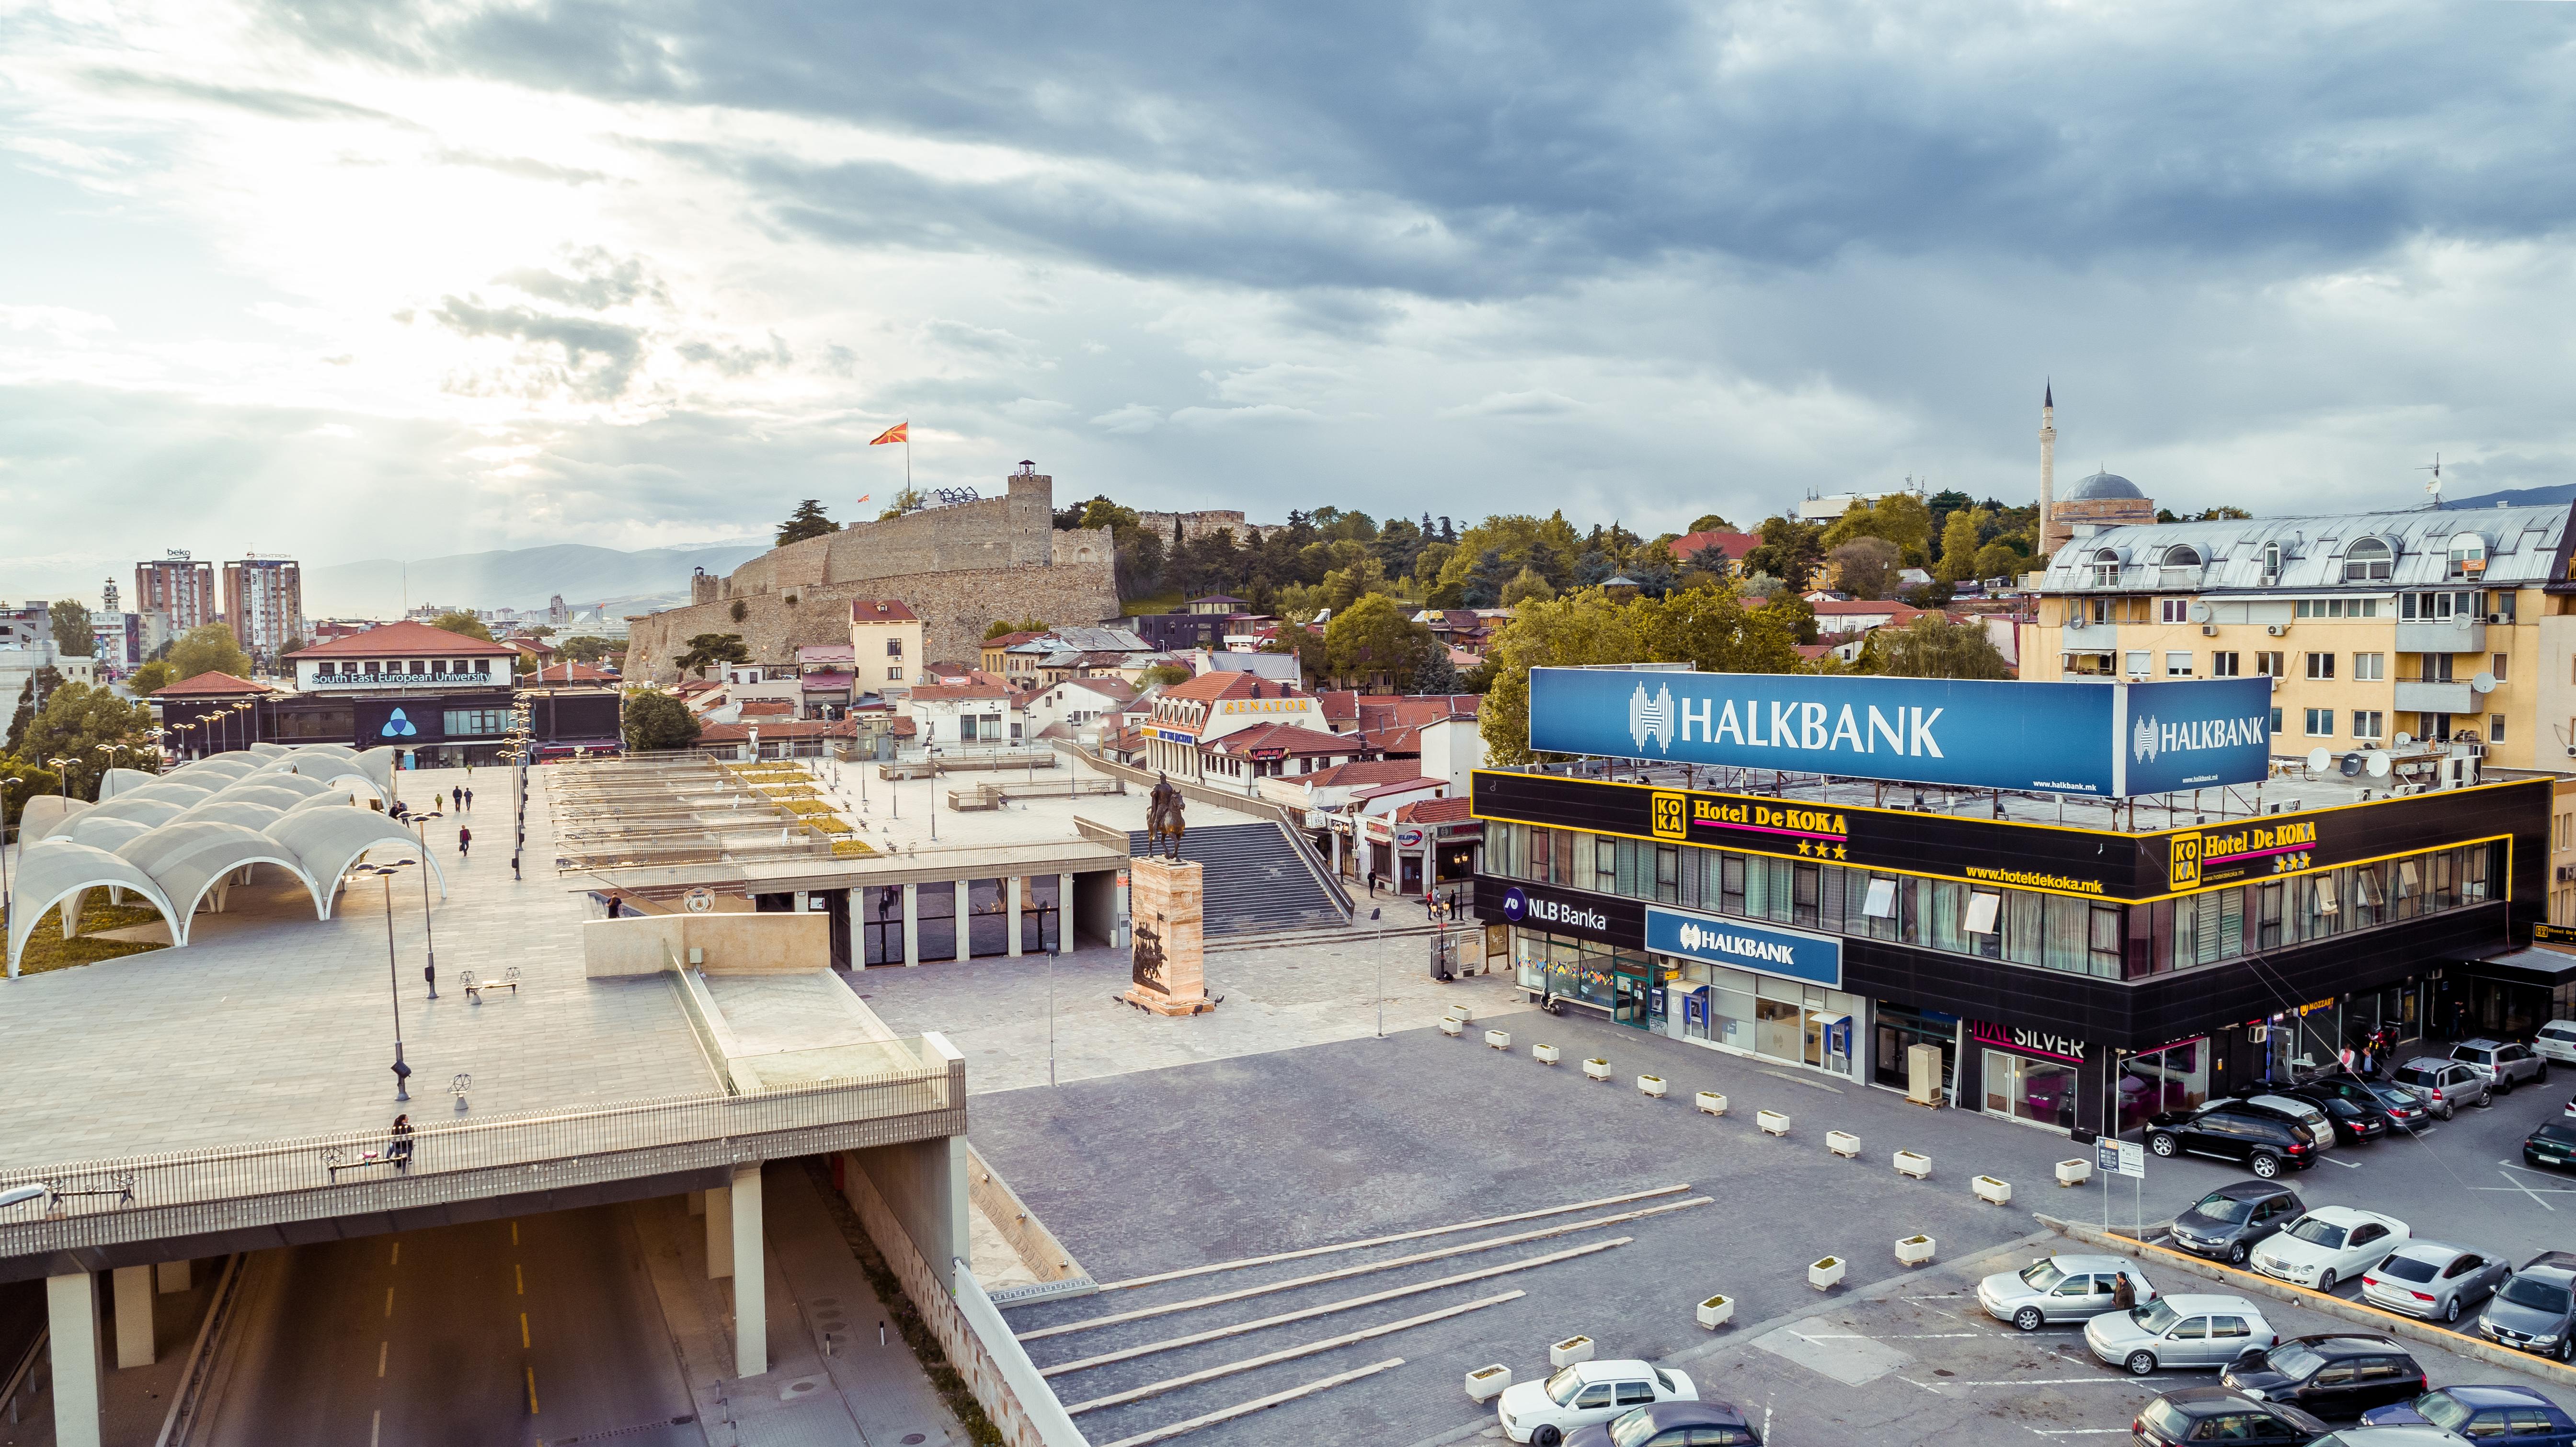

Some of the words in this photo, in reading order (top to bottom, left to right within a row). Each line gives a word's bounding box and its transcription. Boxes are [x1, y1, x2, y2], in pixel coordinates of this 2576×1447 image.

[312, 672, 347, 684] South
[351, 672, 374, 683] East
[378, 672, 432, 684] European
[435, 672, 491, 683] University
[1225, 700, 1307, 714] SENATOR
[1141, 728, 1158, 737] SENATOR
[1682, 697, 1944, 758] HALKBANK
[2162, 717, 2264, 752] HALKBANK
[2033, 781, 2097, 791] www.halkbank.mk
[2182, 775, 2219, 784] www.halkbank.mk
[1658, 799, 1681, 815] KO
[1694, 800, 1749, 823] Hotel
[1454, 825, 1479, 834] BOSCH
[1658, 816, 1681, 832] KA
[2175, 842, 2197, 861] KO
[2204, 831, 2248, 857] Hotel
[2175, 861, 2196, 881] KA
[2202, 869, 2245, 882] www.hoteldekoka.mk
[1966, 867, 2103, 893] www.hoteldekoka.mk
[1529, 898, 1558, 921] NLB
[1561, 904, 1606, 930] Banka
[1702, 932, 1795, 965] HALKBANK
[2309, 997, 2334, 1010] MOZZART
